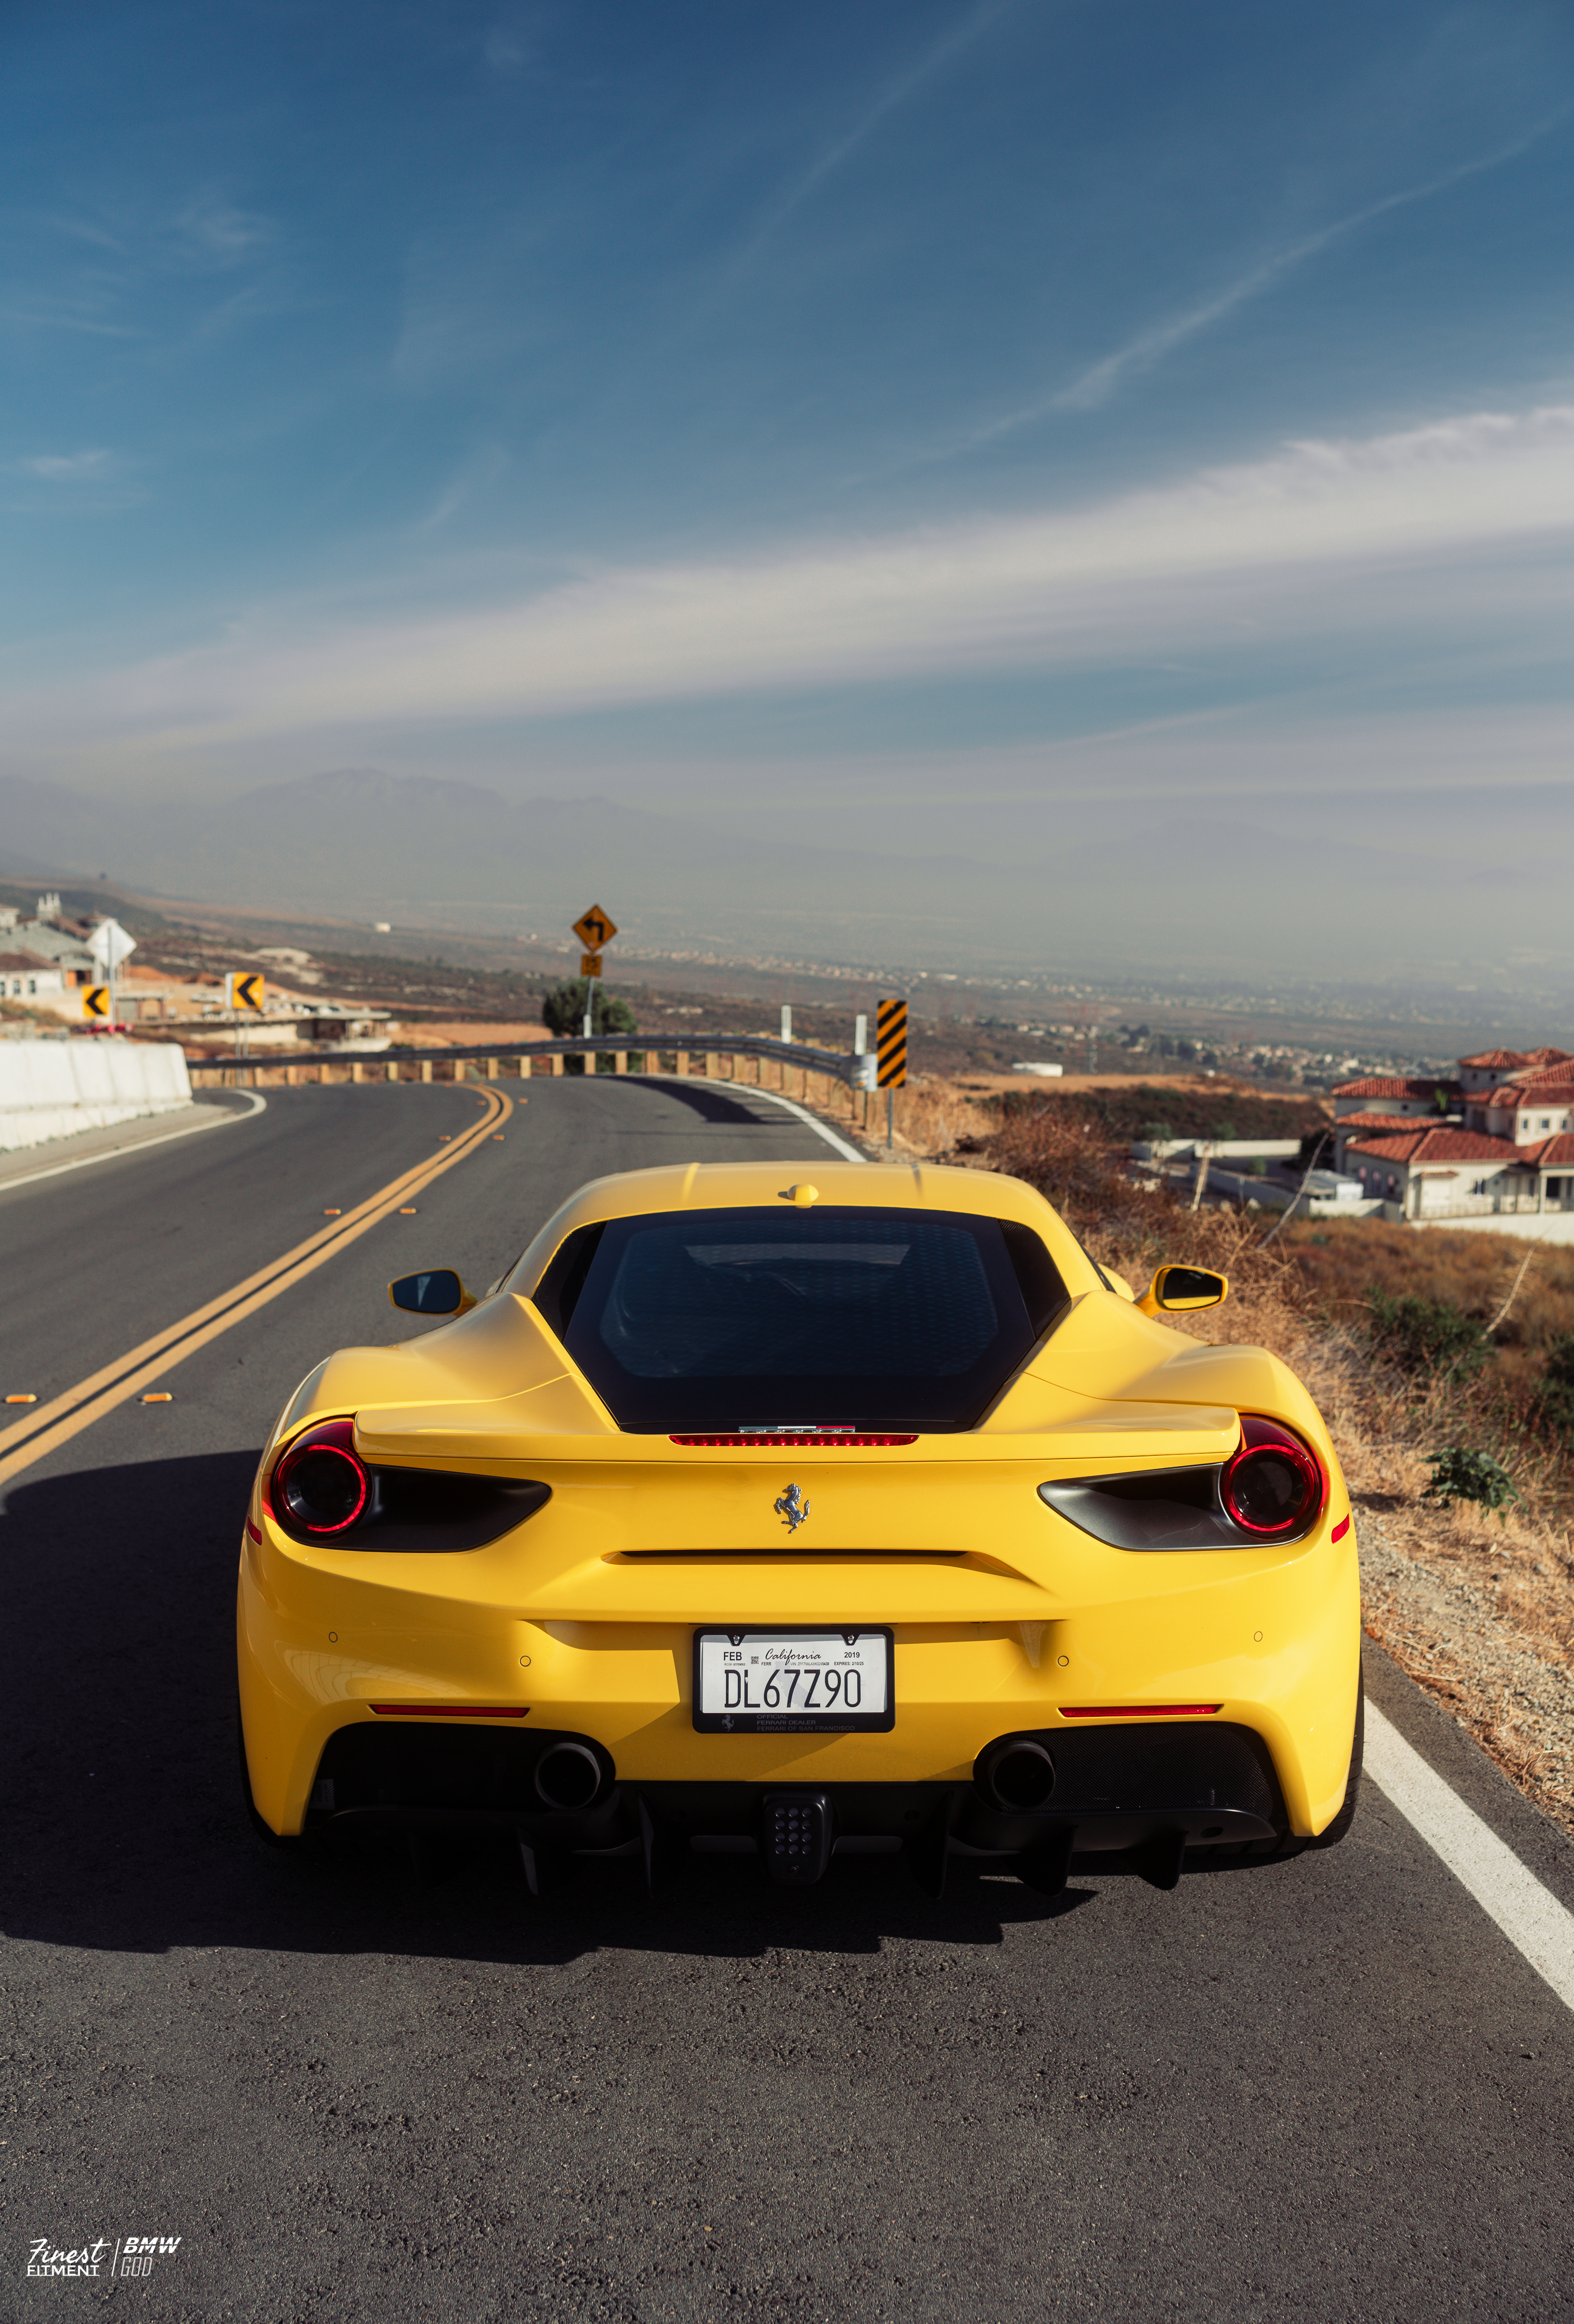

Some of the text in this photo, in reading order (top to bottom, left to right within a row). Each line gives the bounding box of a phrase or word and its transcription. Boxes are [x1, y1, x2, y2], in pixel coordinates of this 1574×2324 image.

[723, 1652, 742, 1661] FEB
[765, 1648, 821, 1666] California
[724, 1669, 861, 1708] DL67Z90
